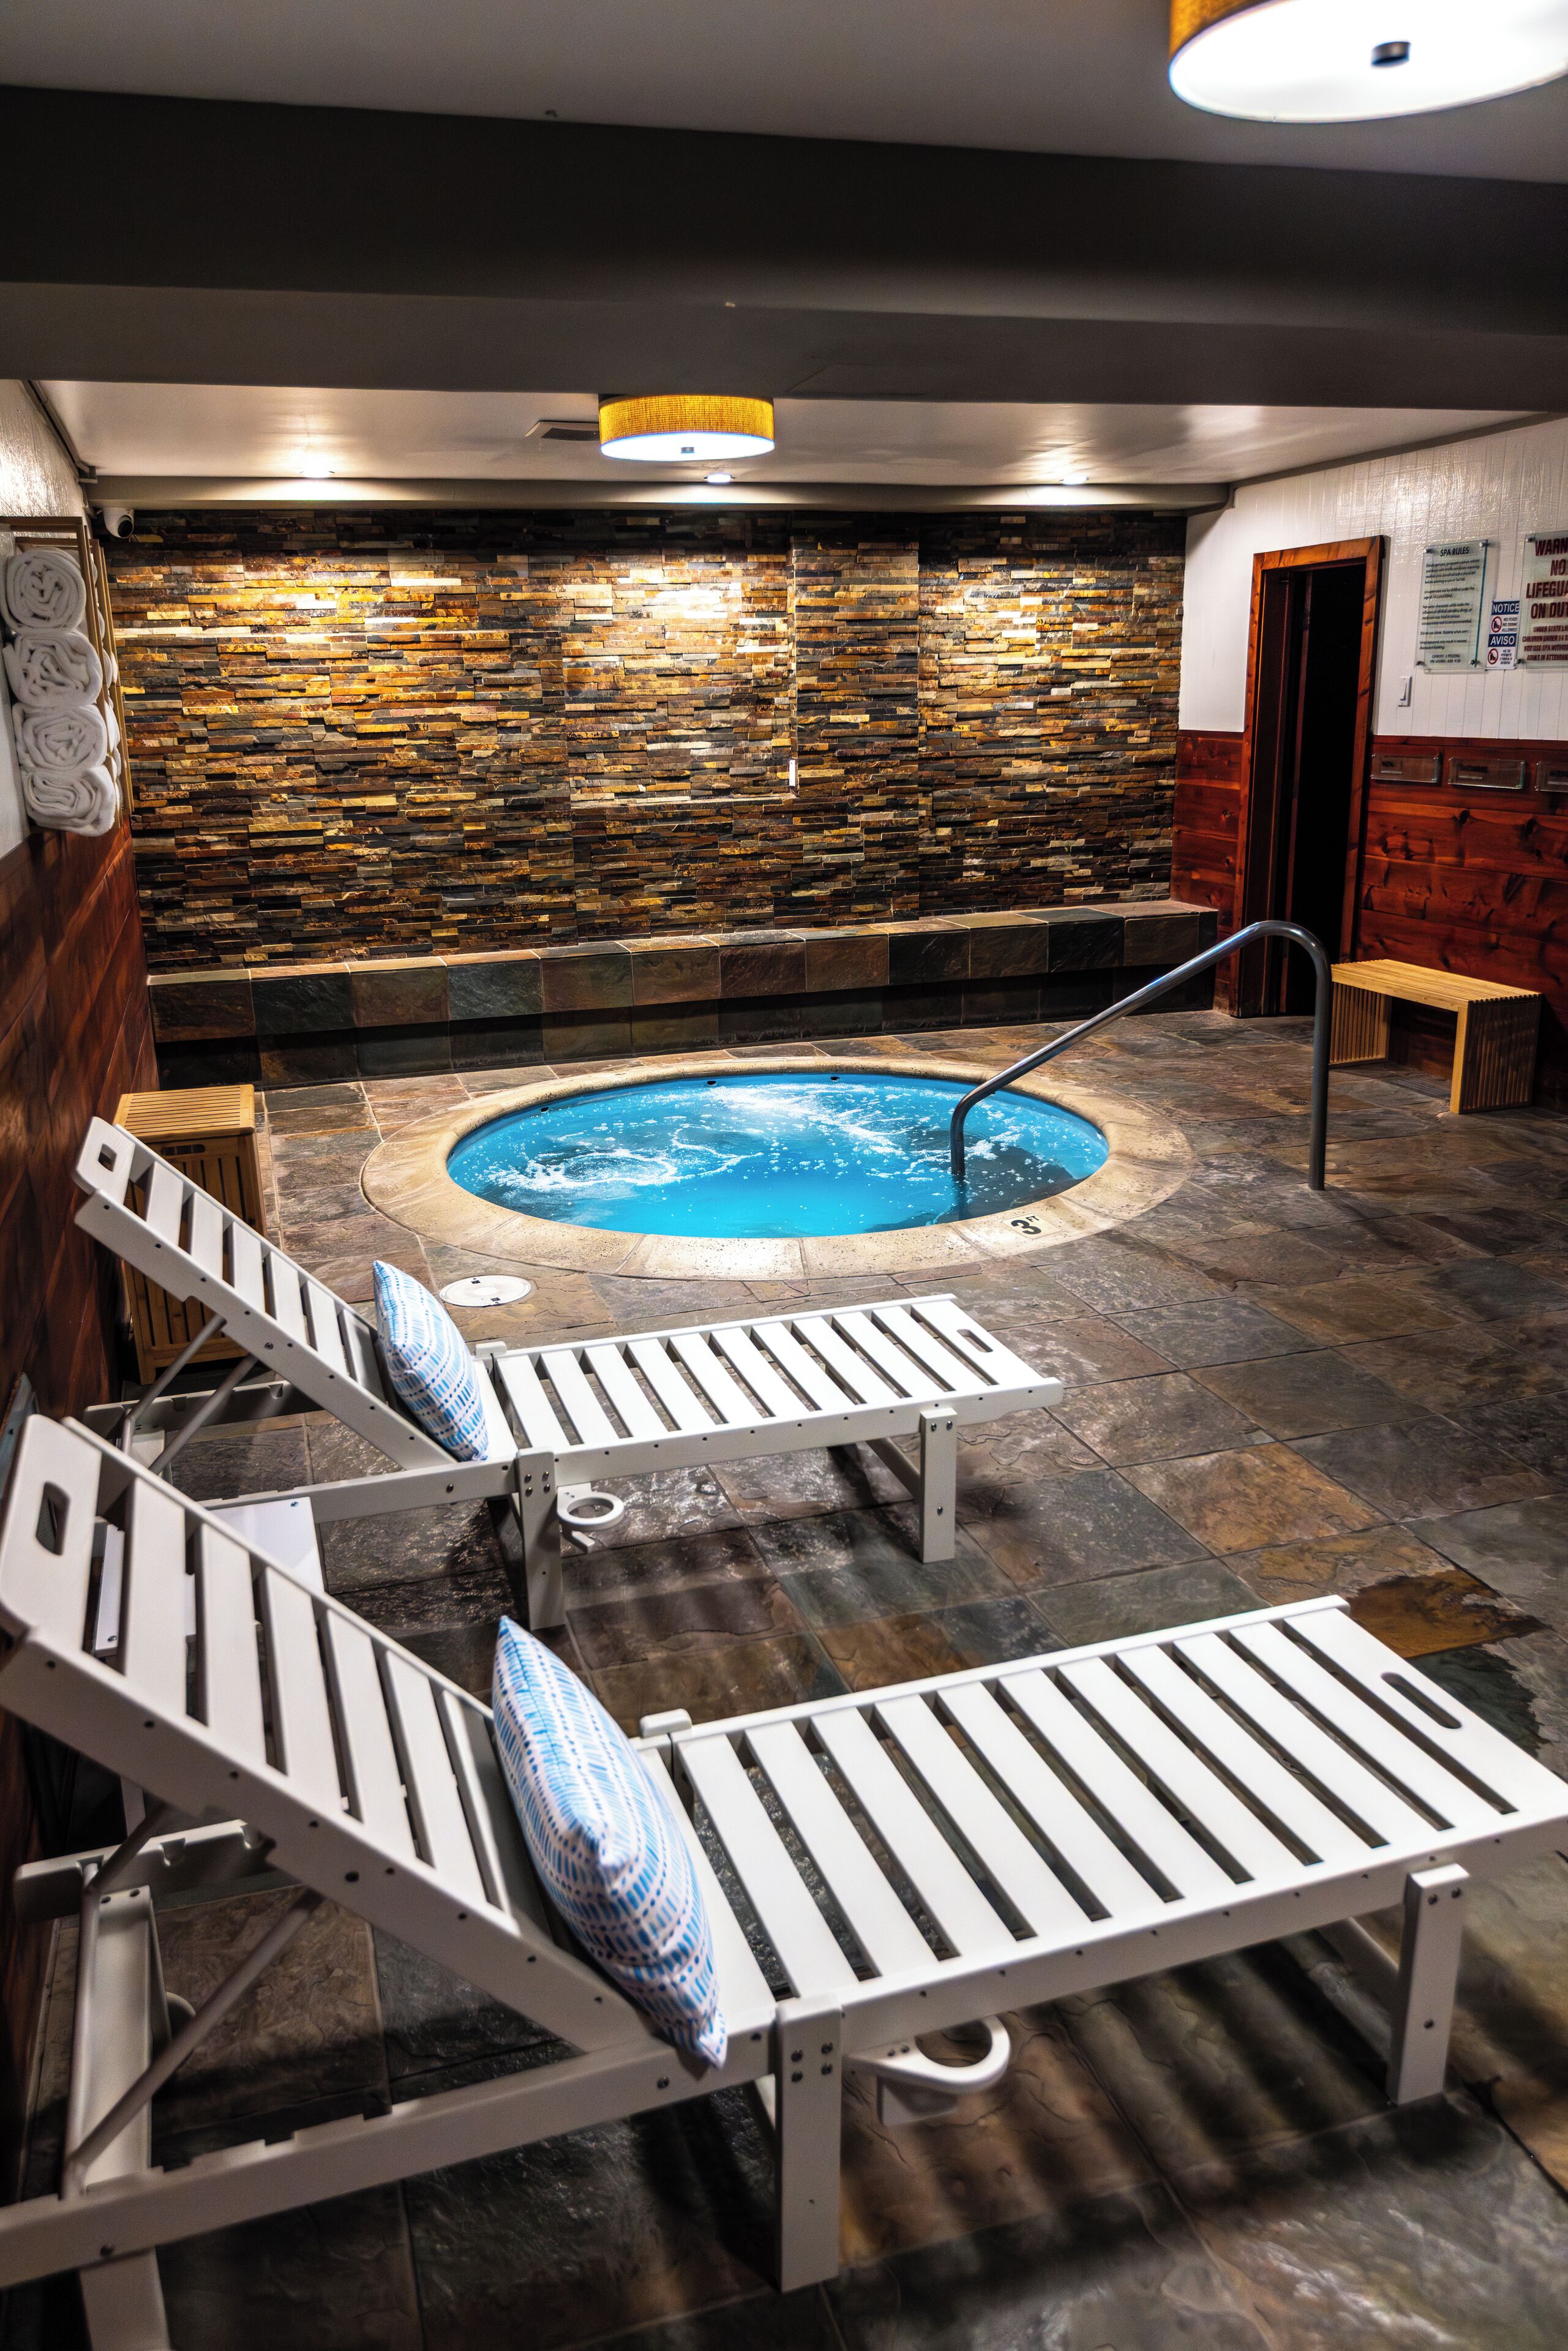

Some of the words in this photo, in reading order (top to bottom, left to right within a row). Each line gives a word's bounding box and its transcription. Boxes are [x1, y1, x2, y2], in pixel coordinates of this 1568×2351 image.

[1452, 546, 1470, 555] RULES
[1492, 604, 1519, 613] NOTICE
[1531, 603, 1547, 619] ON
[1490, 636, 1515, 645] AVISO
[1011, 1220, 1041, 1235] 3
